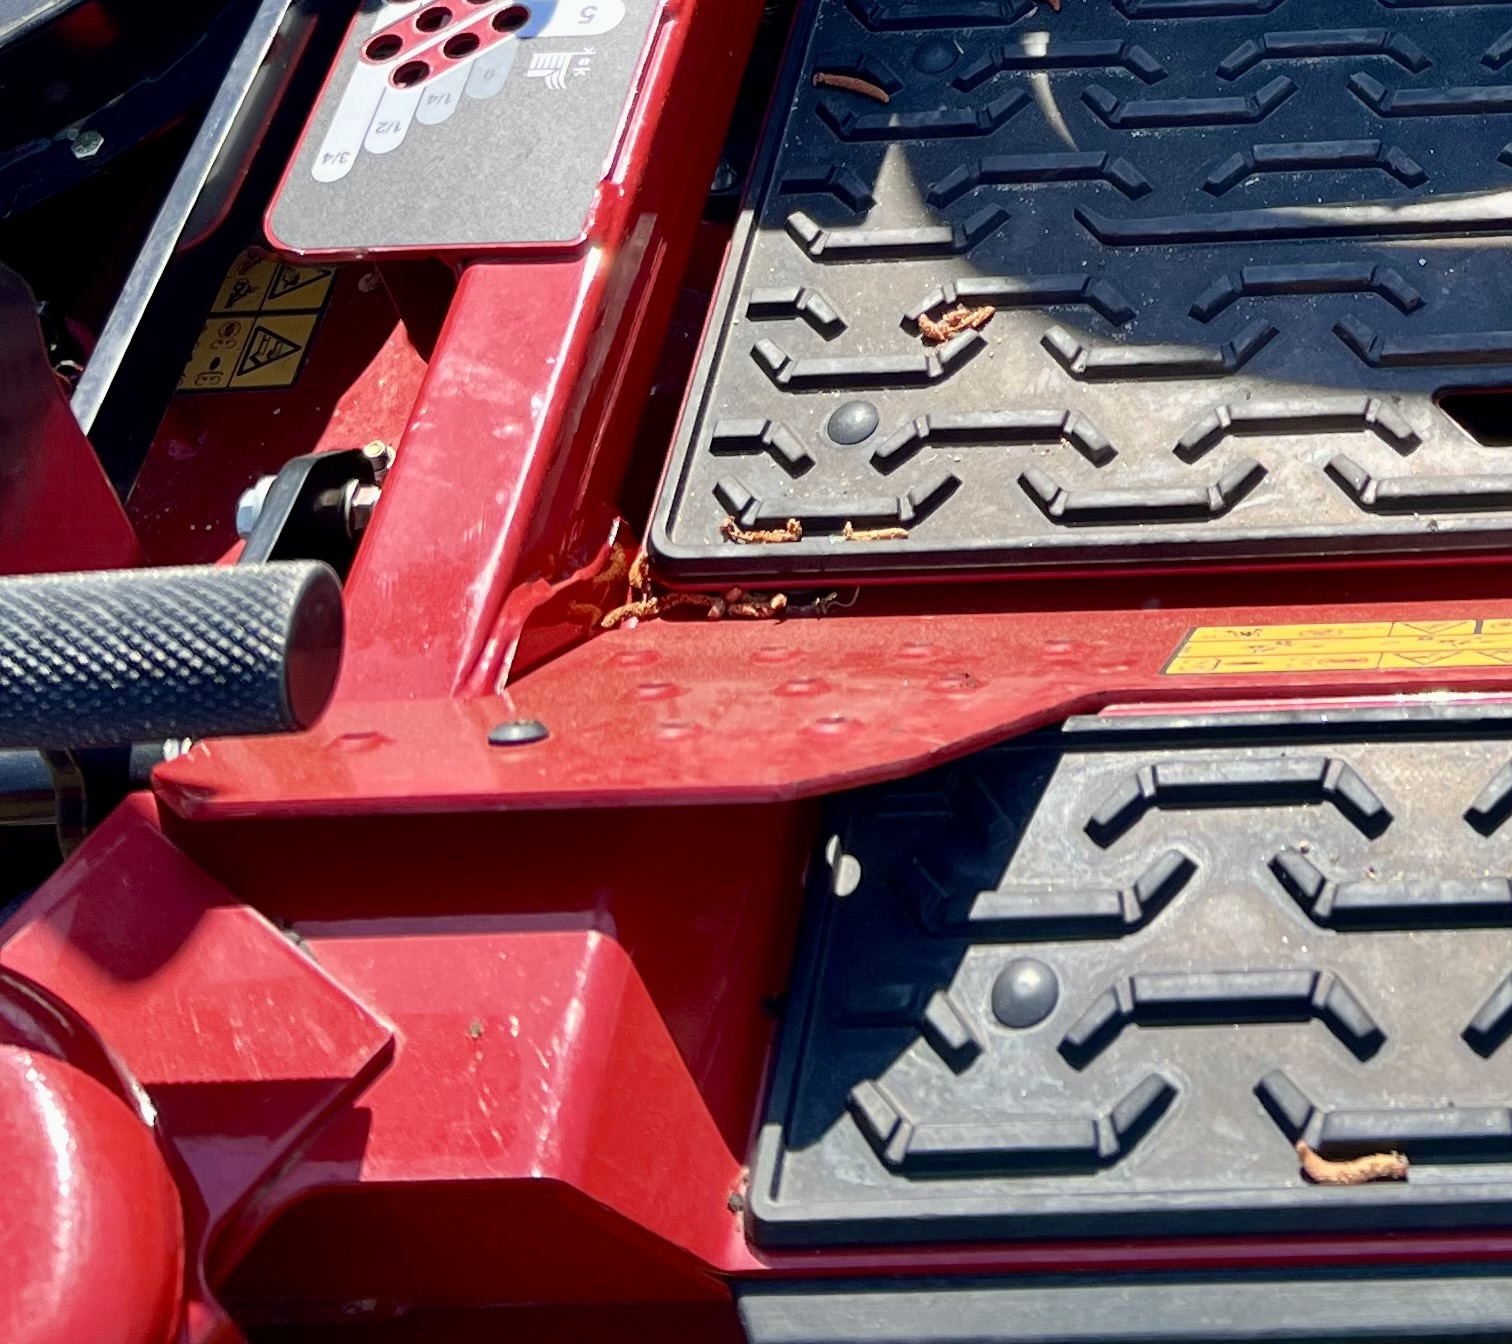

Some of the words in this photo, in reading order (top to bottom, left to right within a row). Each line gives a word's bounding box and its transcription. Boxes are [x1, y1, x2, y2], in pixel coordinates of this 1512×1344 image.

[577, 5, 599, 25] 5
[427, 93, 452, 106] 1/4
[375, 121, 402, 134] 1/2
[322, 152, 351, 165] 3/4
